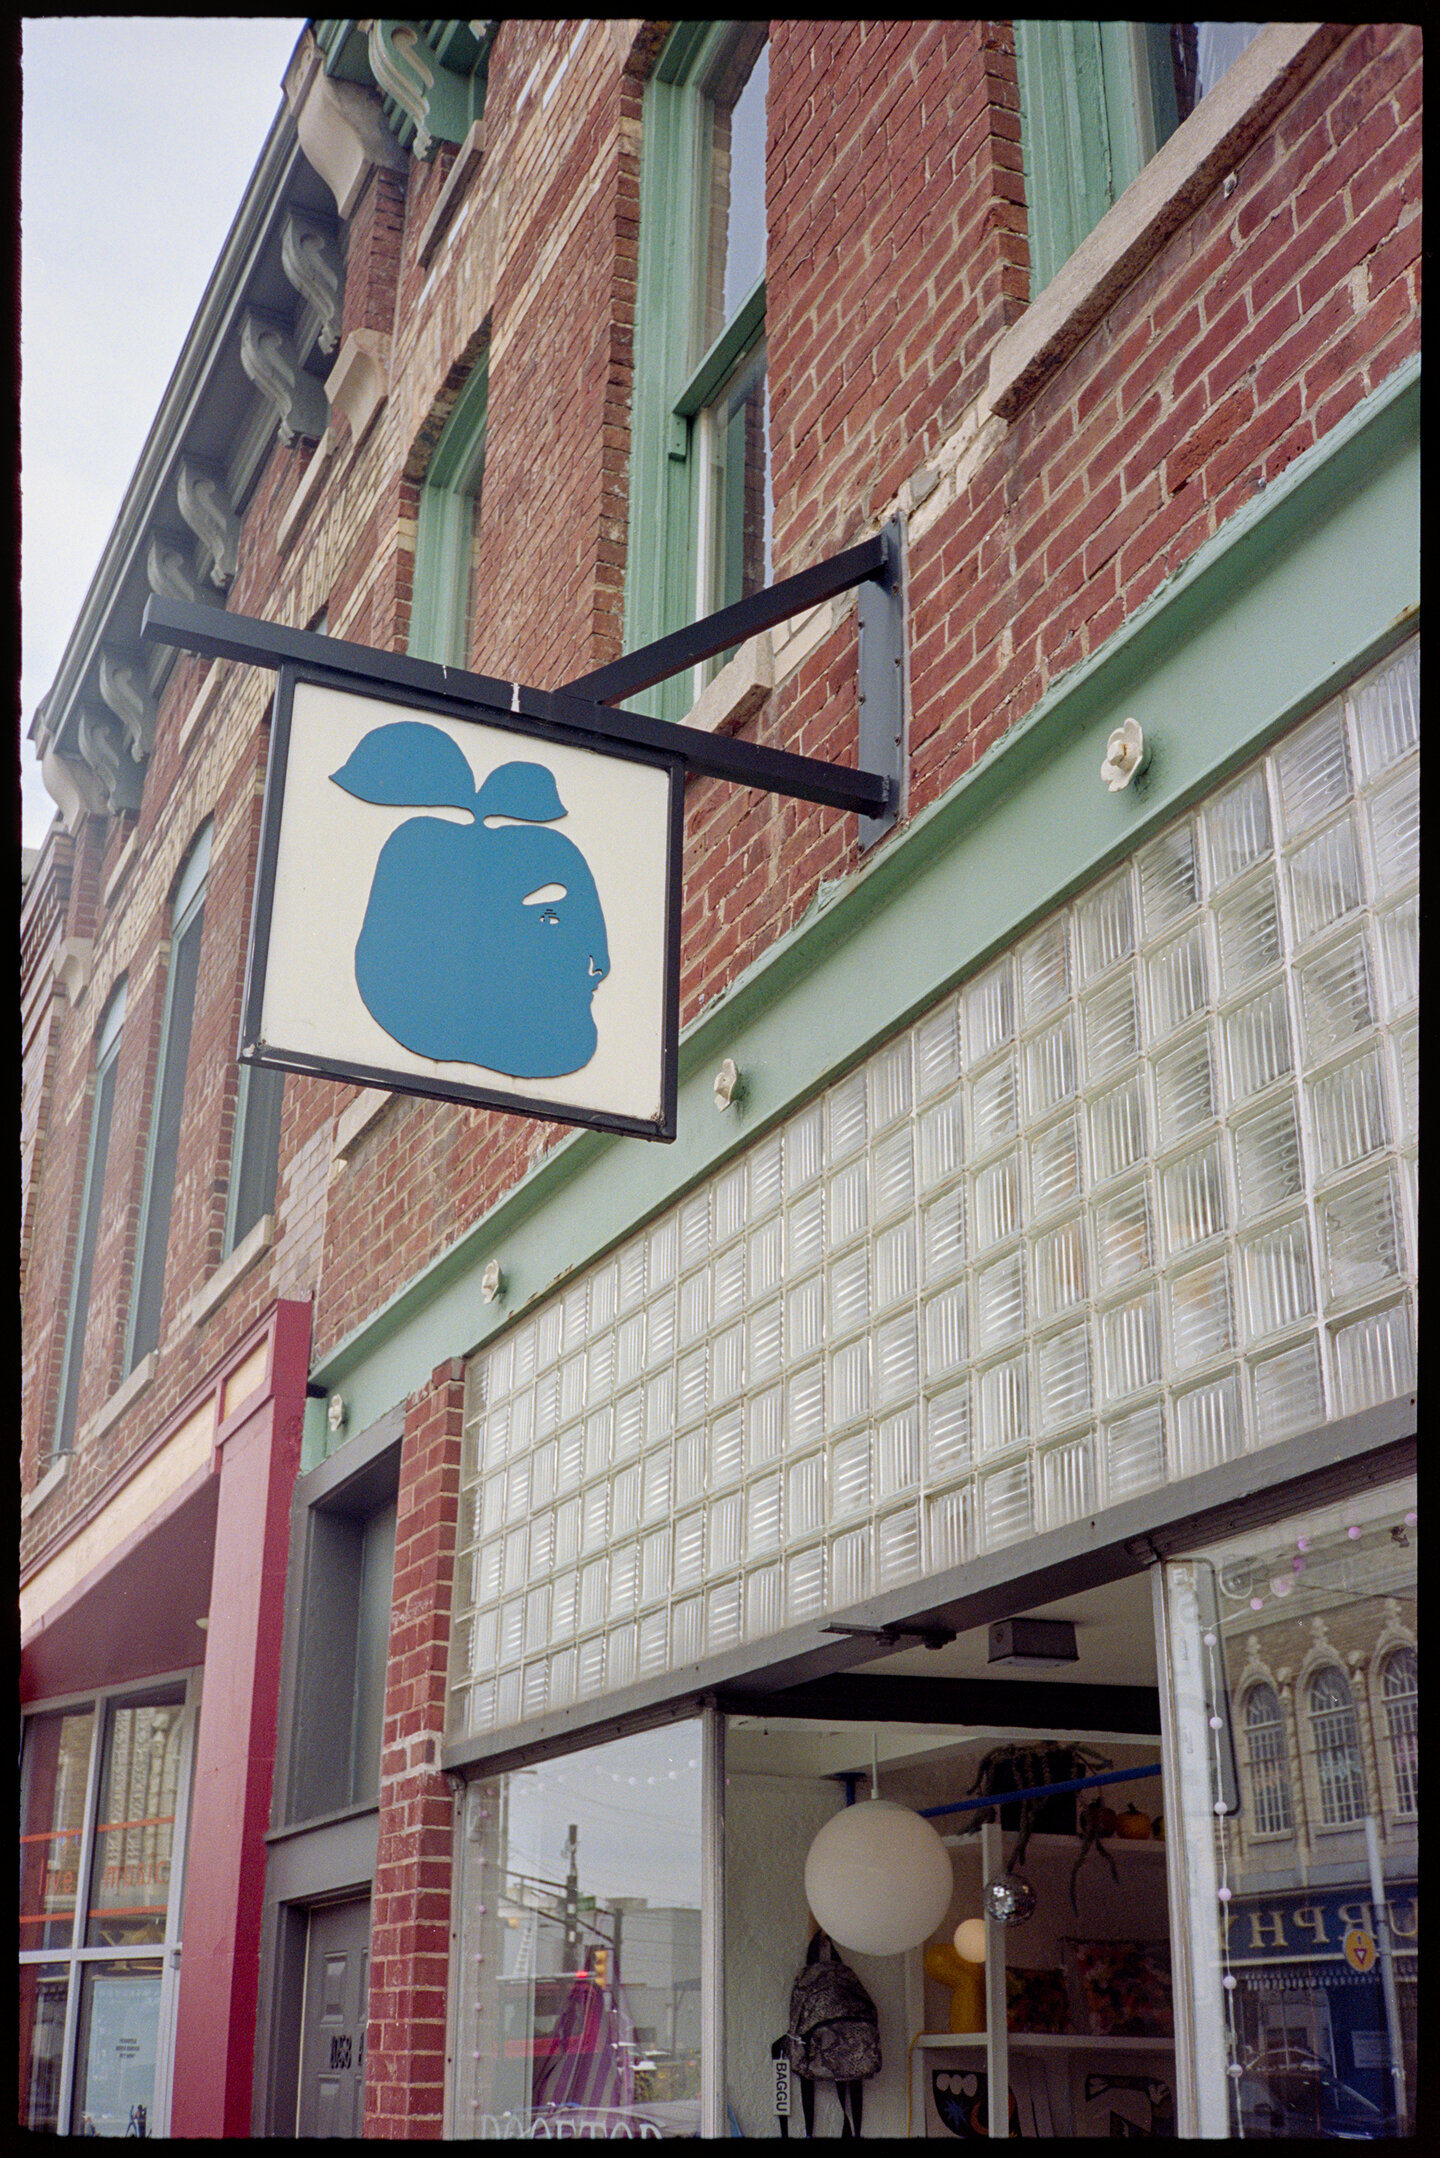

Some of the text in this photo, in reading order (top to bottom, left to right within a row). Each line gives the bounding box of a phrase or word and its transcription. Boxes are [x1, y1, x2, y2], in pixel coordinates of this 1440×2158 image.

[38, 1852, 166, 1895] live music
[776, 2062, 788, 2112] BAGGU
